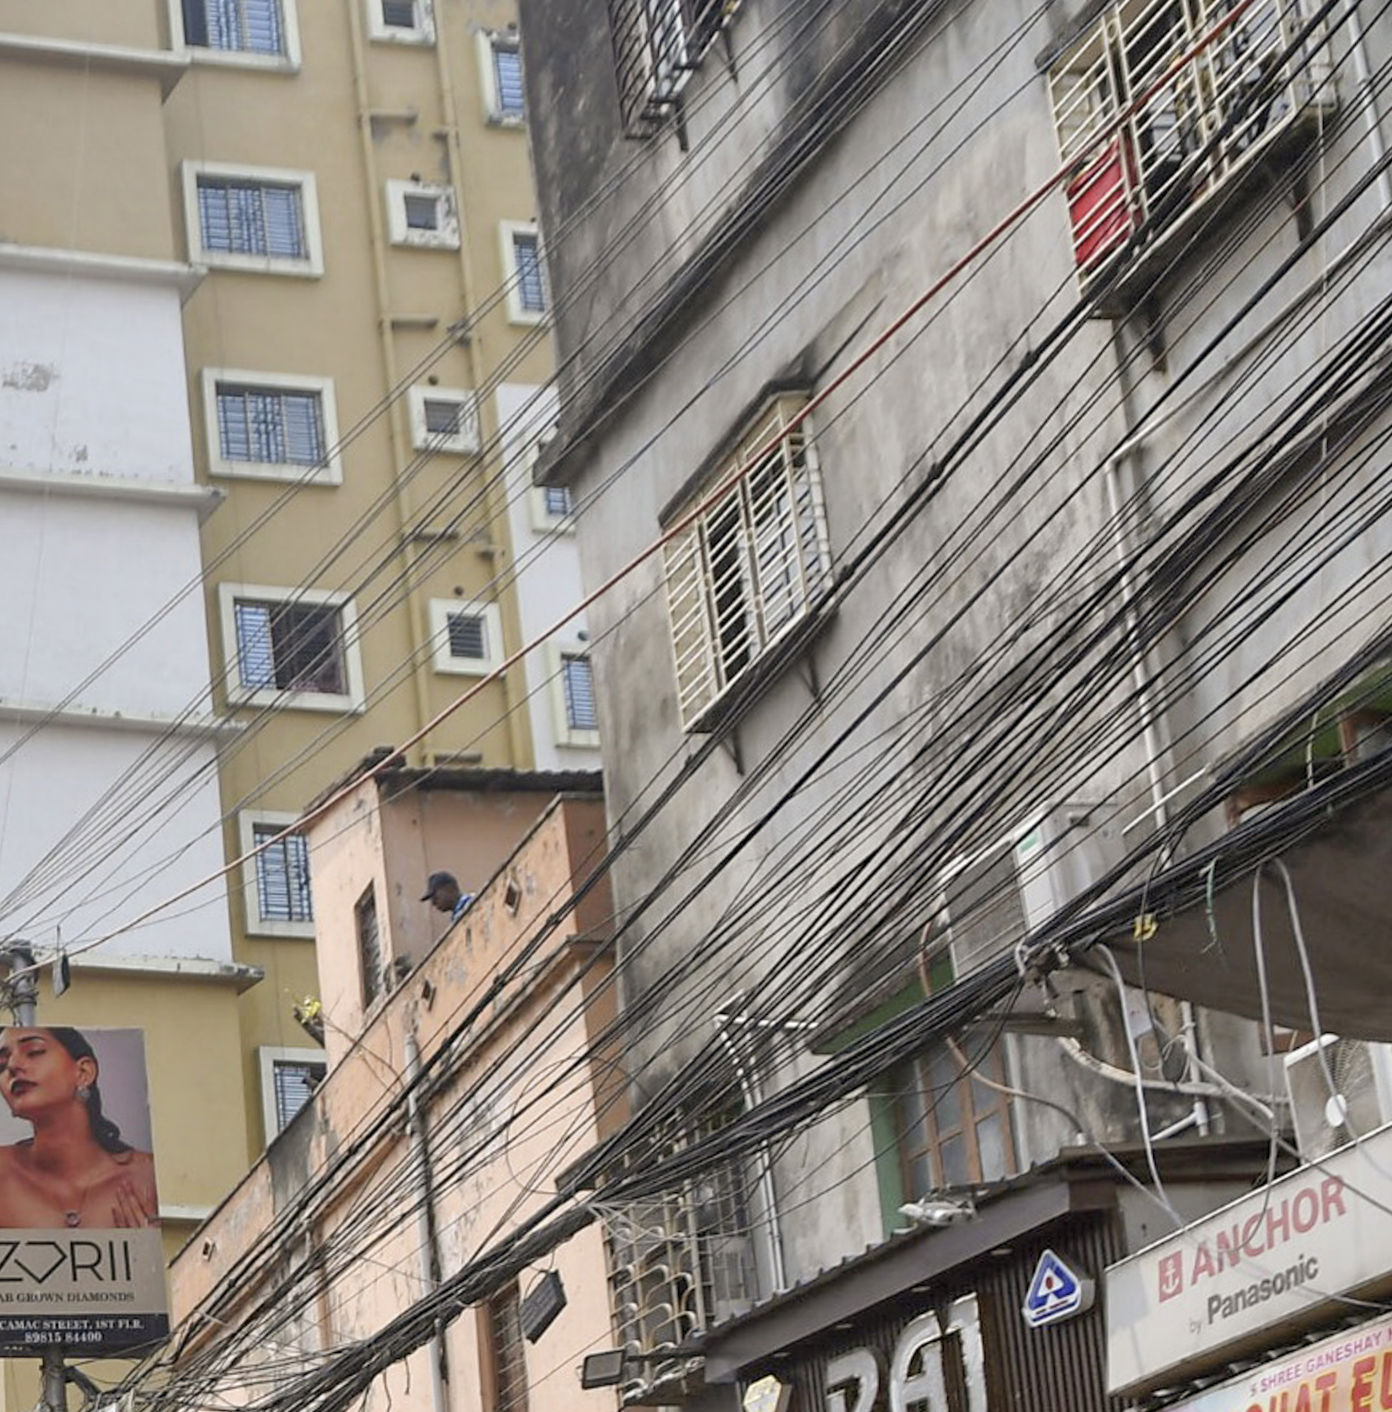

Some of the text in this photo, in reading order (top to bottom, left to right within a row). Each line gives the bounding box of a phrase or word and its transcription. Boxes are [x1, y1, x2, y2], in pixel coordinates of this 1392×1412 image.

[1191, 1175, 1347, 1286] ANCHOR
[16, 1292, 64, 1303] GROWN
[67, 1291, 135, 1303] DIAMONDS
[96, 1319, 115, 1330] 1ST
[1189, 1254, 1319, 1335] by Panasonic
[1260, 1364, 1302, 1392] SHREE
[1306, 1331, 1382, 1373] GANESHAY
